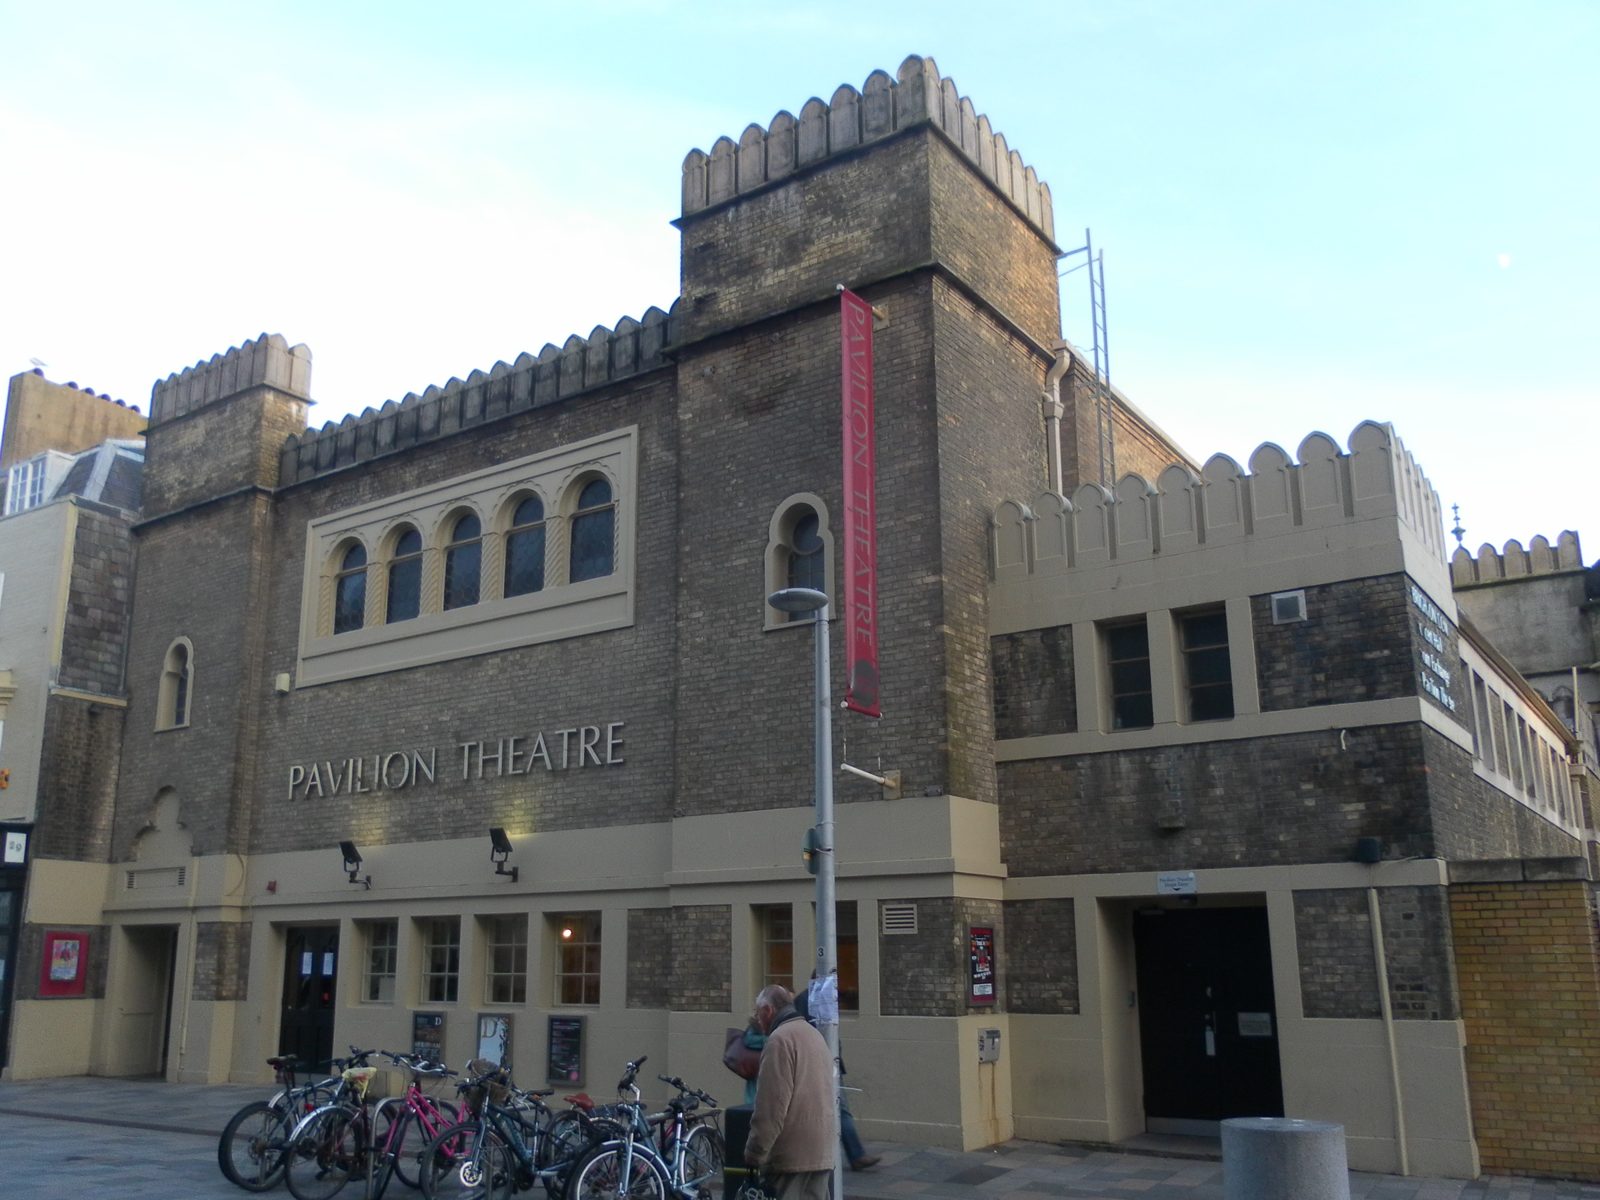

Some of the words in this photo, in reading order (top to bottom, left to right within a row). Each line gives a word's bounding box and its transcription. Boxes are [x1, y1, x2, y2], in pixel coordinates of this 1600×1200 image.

[850, 302, 868, 468] PAVILION
[853, 487, 873, 646] THEATRE
[288, 747, 437, 800] PAVILION
[459, 721, 625, 780] THEATRE
[818, 947, 824, 957] 3
[435, 1017, 442, 1026] D
